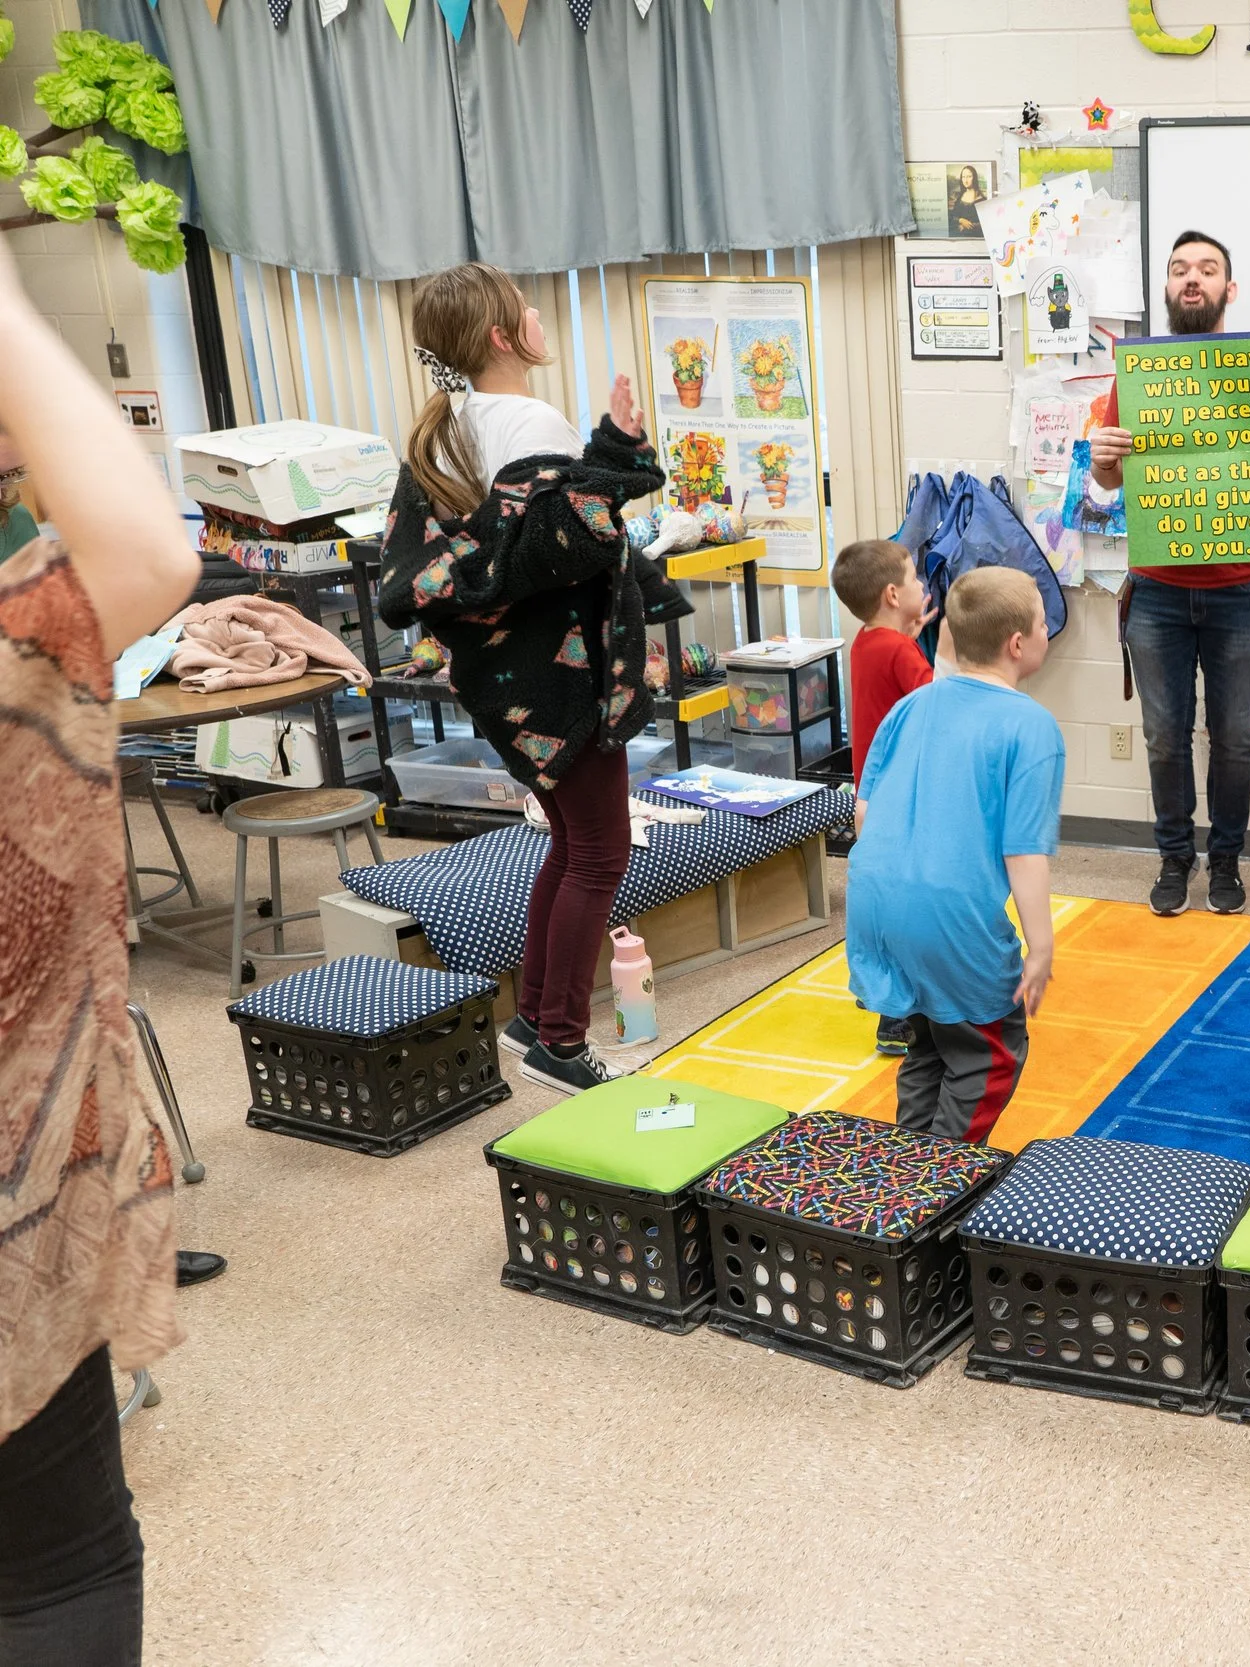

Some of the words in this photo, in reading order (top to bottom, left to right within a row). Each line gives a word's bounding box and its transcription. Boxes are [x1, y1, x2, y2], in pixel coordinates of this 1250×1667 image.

[1125, 353, 1192, 373] Peace
[1199, 350, 1207, 369] I
[1144, 376, 1200, 397] with
[1138, 407, 1174, 427] my
[1182, 403, 1250, 426] peace
[1132, 430, 1185, 453] give
[1193, 429, 1219, 446] to
[1145, 464, 1188, 483] Not
[1195, 466, 1221, 481] as
[1138, 487, 1207, 509] world
[1157, 514, 1187, 534] do
[1195, 513, 1203, 531] I
[1168, 541, 1194, 558] to
